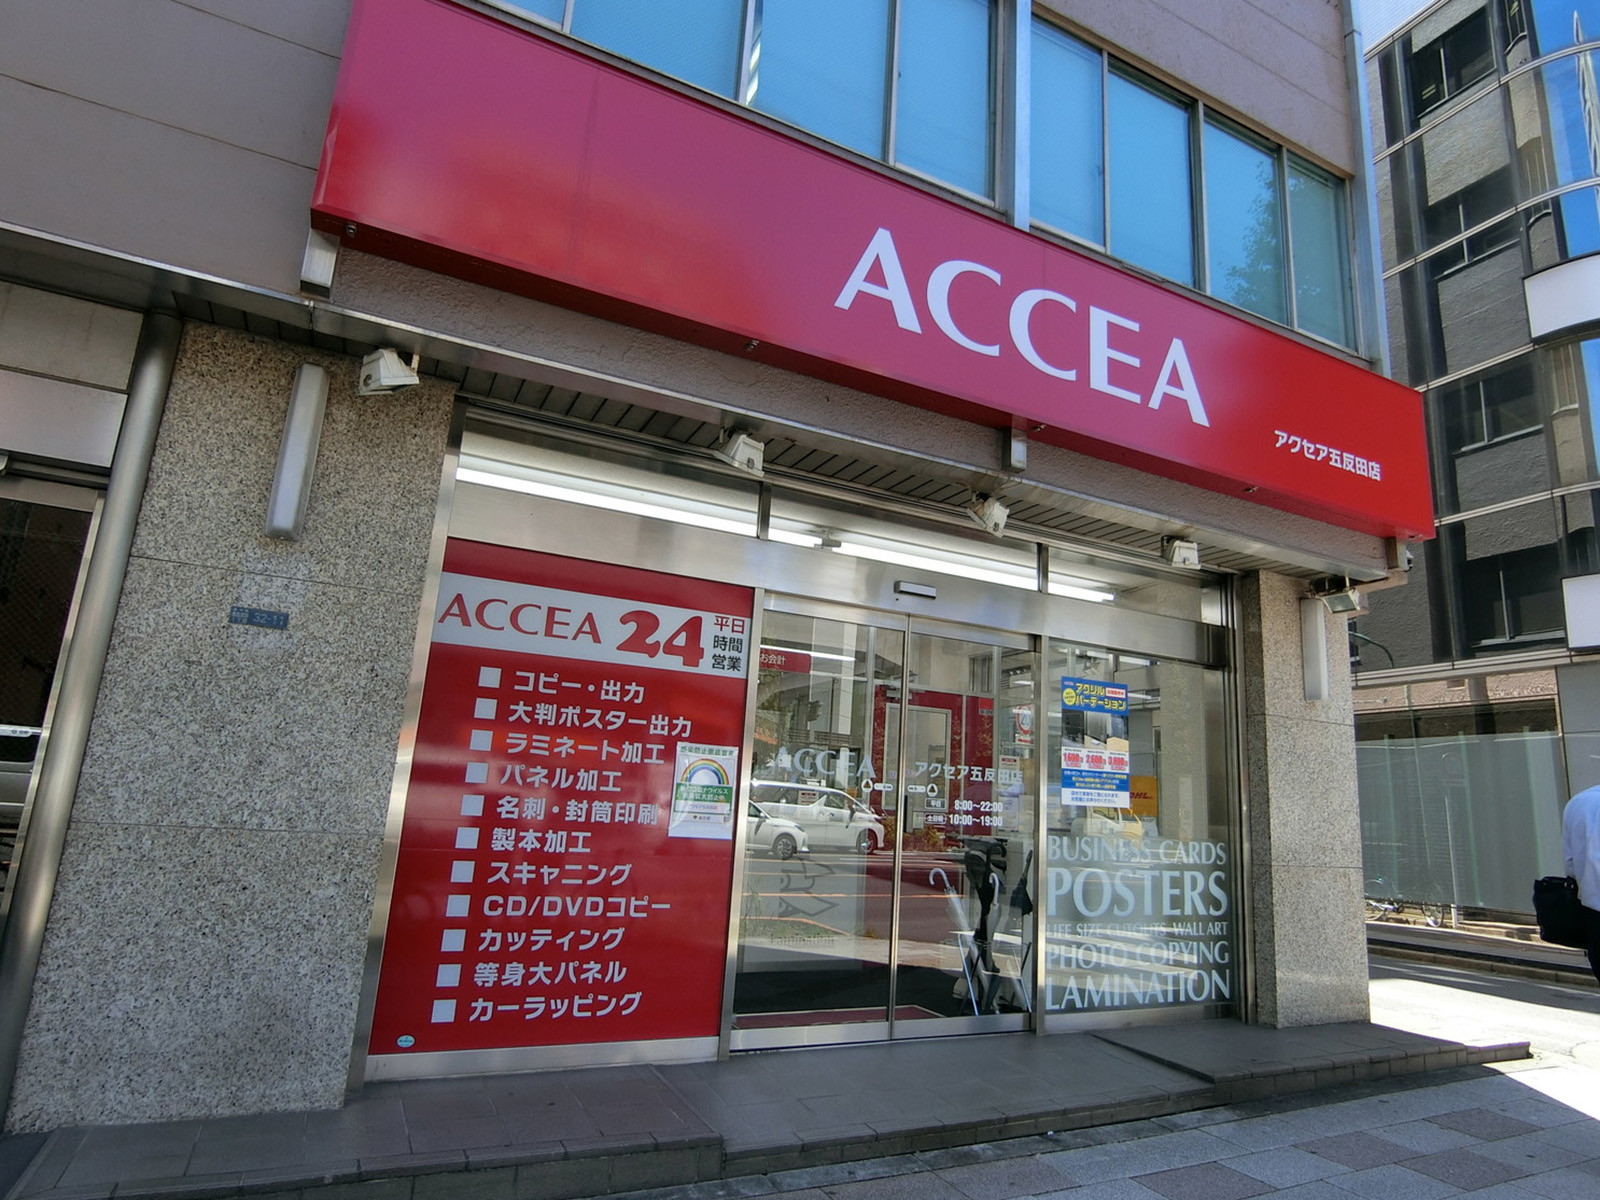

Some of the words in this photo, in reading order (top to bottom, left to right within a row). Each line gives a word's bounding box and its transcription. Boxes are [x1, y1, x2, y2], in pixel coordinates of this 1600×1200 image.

[834, 227, 1210, 428] ACCEA
[1274, 430, 1381, 481] アクセア五反田店
[438, 593, 602, 645] ACCEA
[616, 609, 705, 668] 24
[713, 615, 745, 634] 平日
[712, 634, 743, 654] 時間
[711, 653, 742, 672] 営業
[513, 669, 645, 704] コピー・出力
[1075, 683, 1105, 696] アクリル
[1074, 695, 1126, 711] パーテーション
[508, 702, 692, 738] 大判ポスター出力
[505, 732, 665, 766] ラミネート加工
[771, 746, 877, 779] ACCEA
[500, 763, 622, 793] パネル加工
[914, 761, 1024, 784] アクセア五反田店
[495, 794, 659, 826] 名刺・封筒印刷
[490, 827, 592, 853] 製本加工
[1047, 835, 1151, 863] BUSINESS
[1158, 840, 1227, 865] CARDS
[486, 861, 632, 886] スキャニング
[483, 895, 671, 918] CD/DVDコピー
[1047, 867, 1228, 918] POSTERS
[477, 926, 625, 952] カッティング
[1046, 922, 1072, 938] LIFE
[1076, 923, 1102, 938] SIZE
[1172, 921, 1208, 936] WALL
[1206, 921, 1228, 936] ART
[1046, 943, 1130, 971] PHOTO
[1135, 940, 1230, 967] COPYING
[473, 961, 628, 988] 等身大パネル
[1046, 969, 1230, 1010] LAMINATION
[468, 991, 643, 1023] カーラッピング
